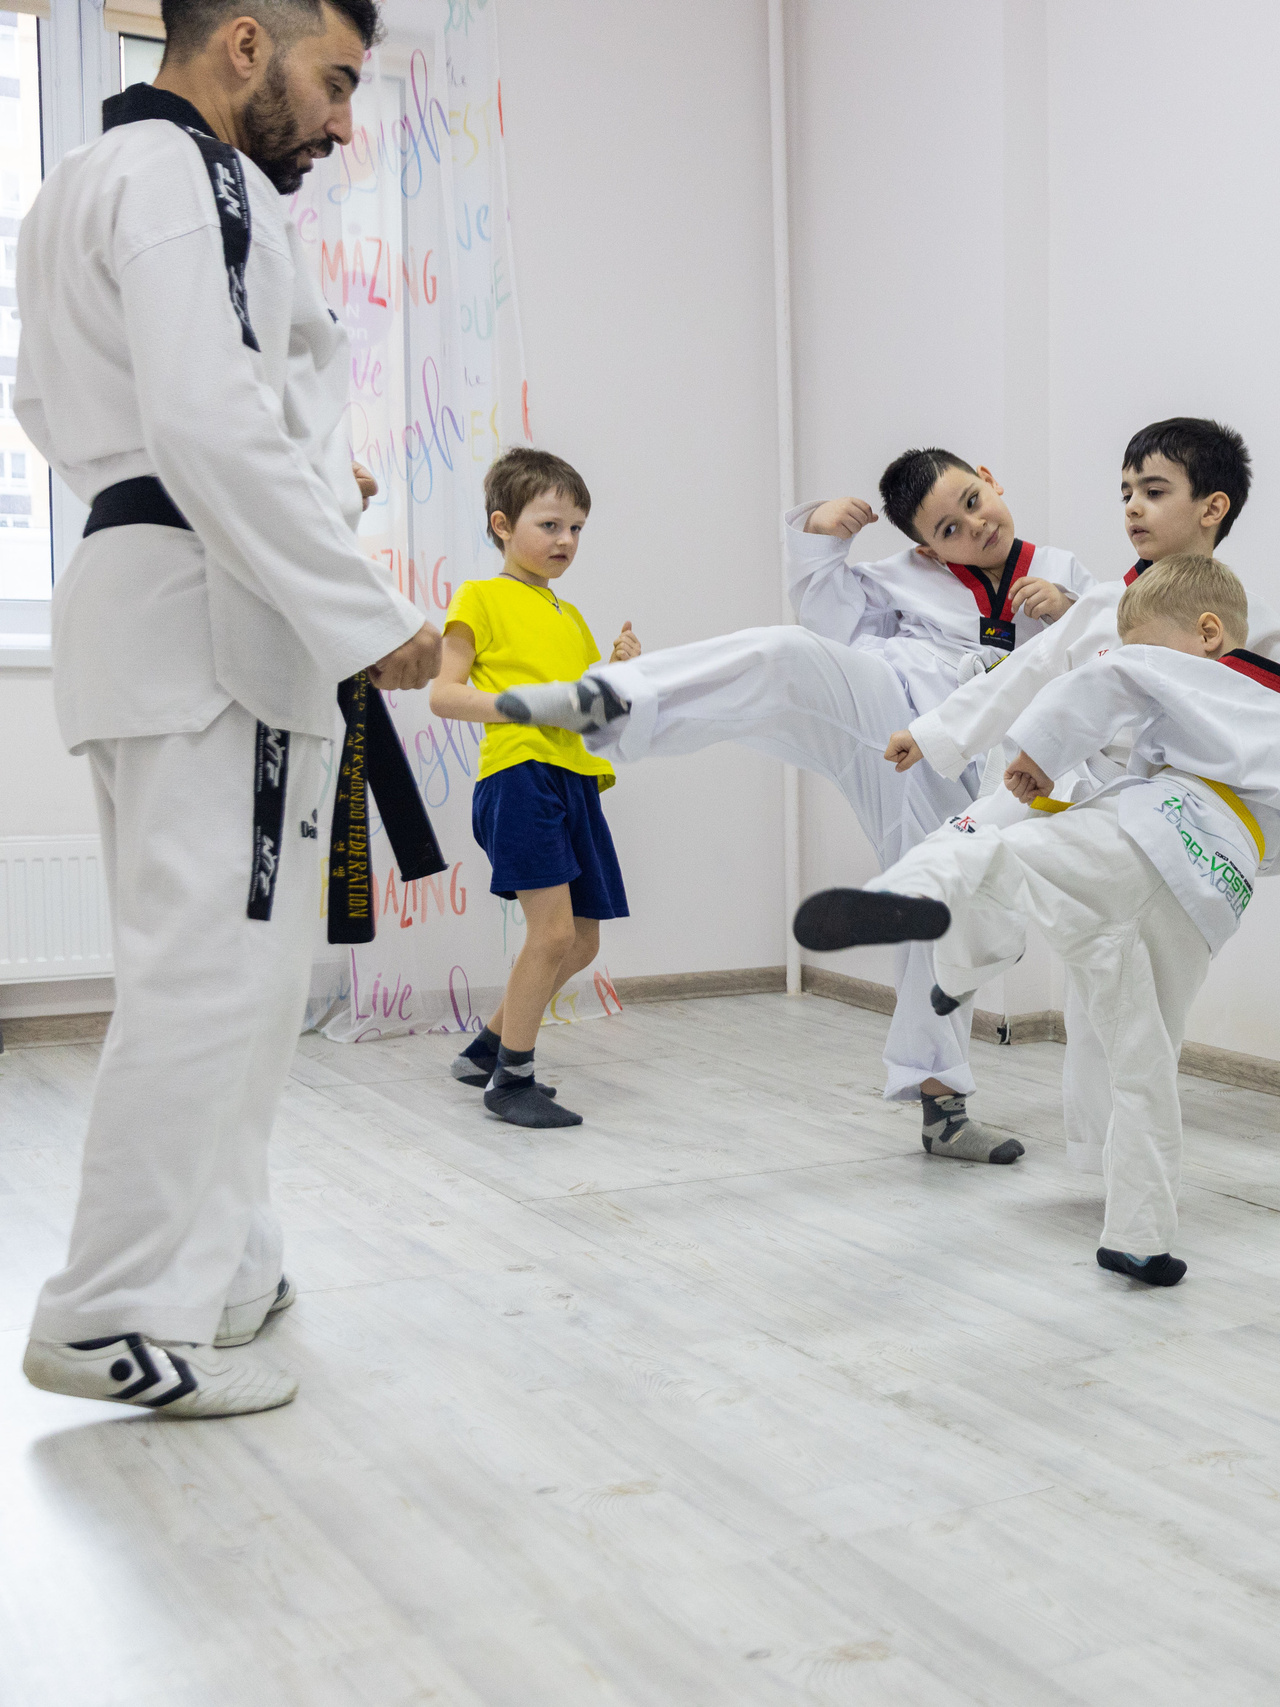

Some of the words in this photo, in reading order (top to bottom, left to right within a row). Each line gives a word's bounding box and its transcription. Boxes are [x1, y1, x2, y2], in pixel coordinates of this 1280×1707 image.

[321, 237, 437, 312] MAZING
[348, 825, 369, 917] FEDERATION
[350, 947, 413, 1021] Live
